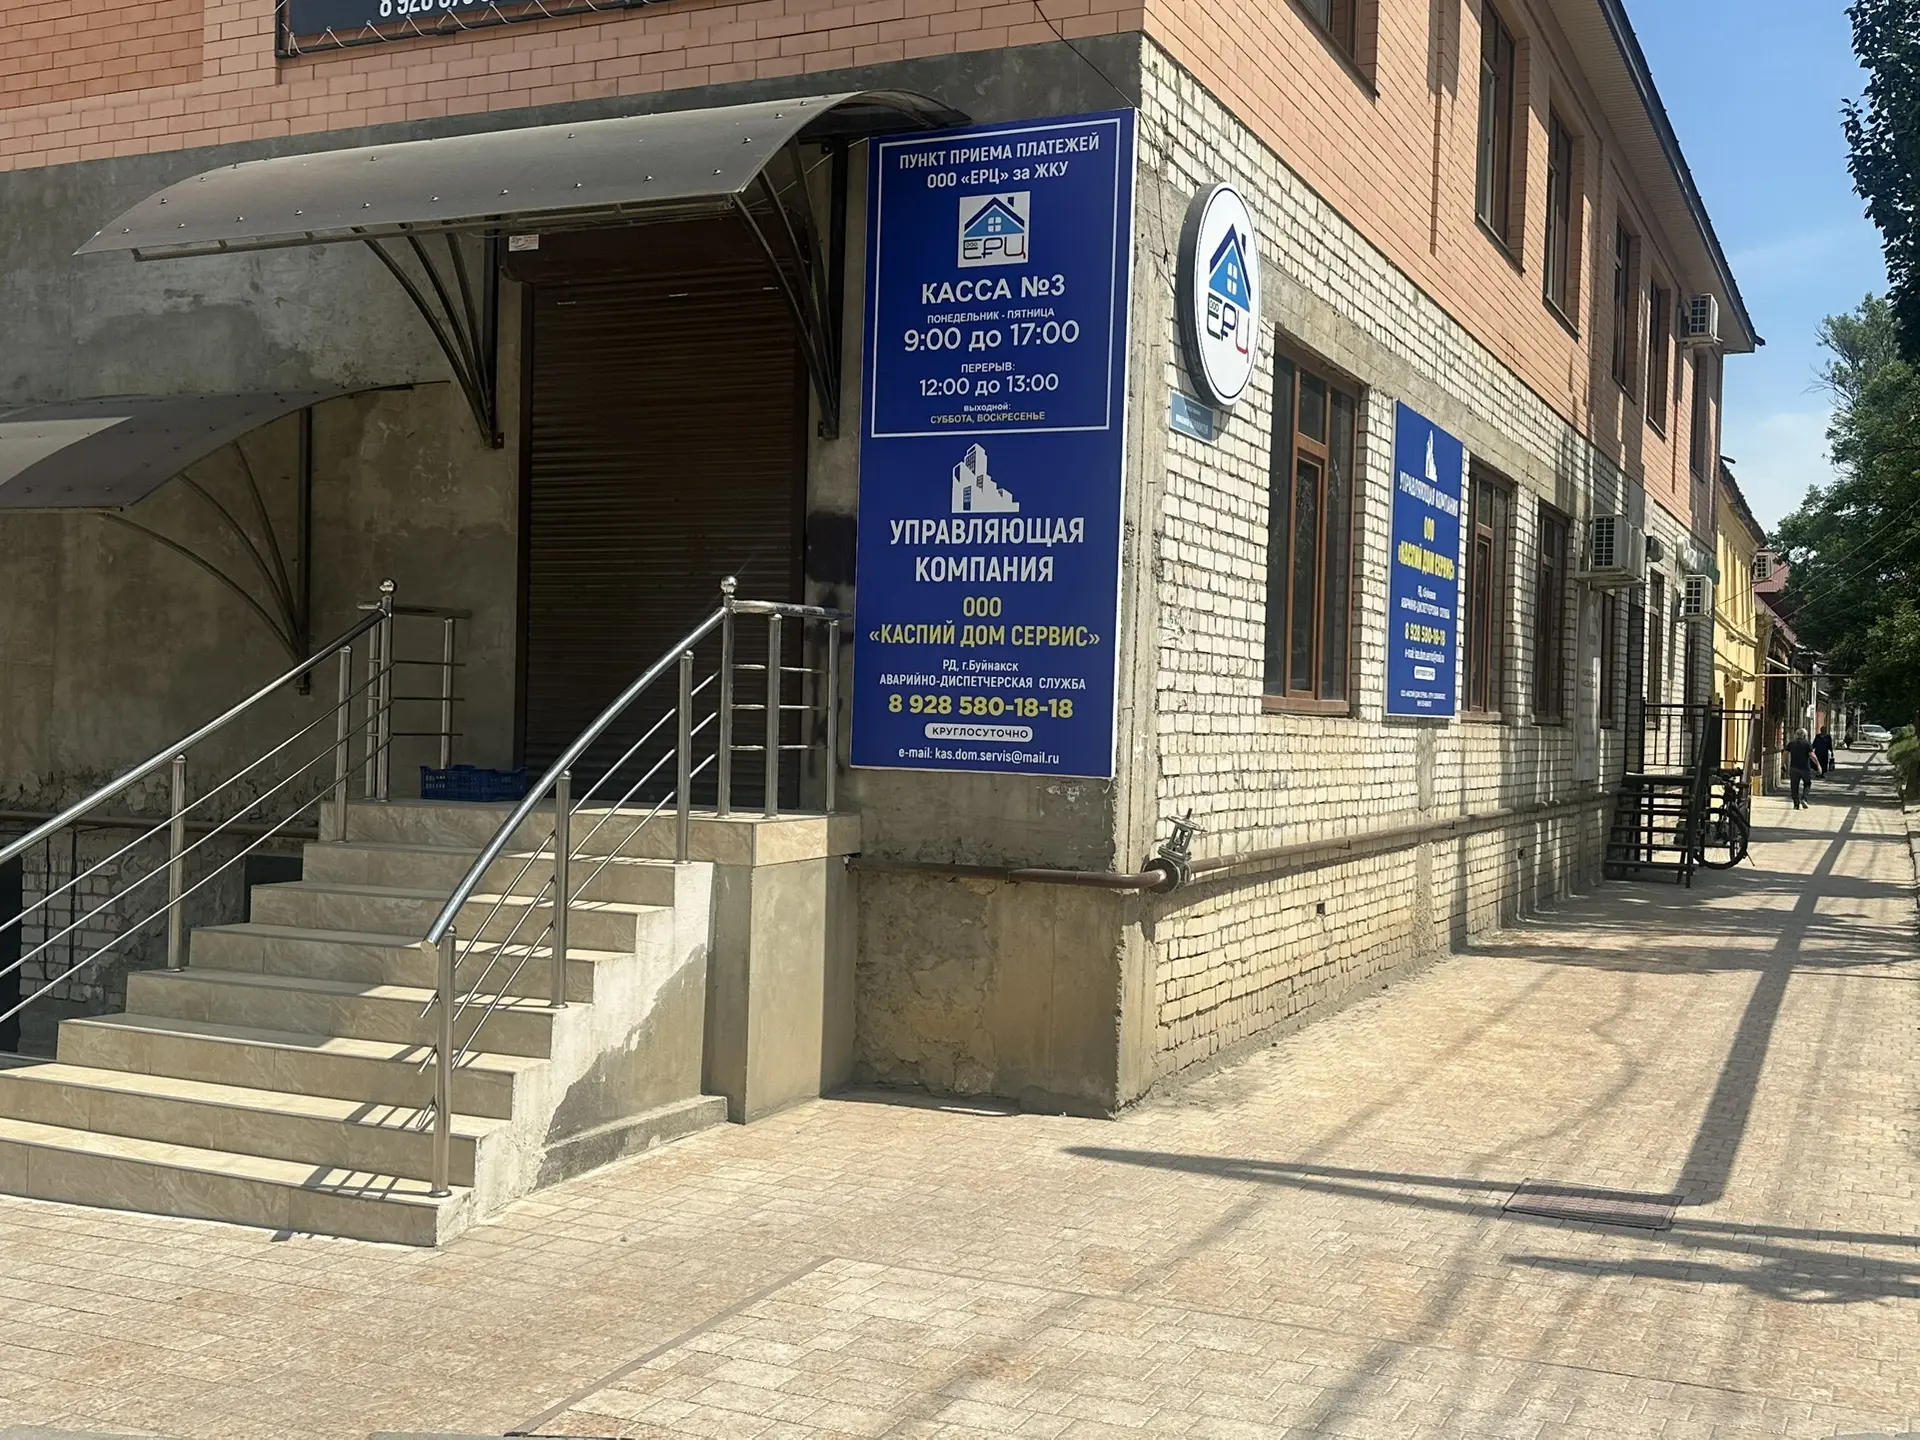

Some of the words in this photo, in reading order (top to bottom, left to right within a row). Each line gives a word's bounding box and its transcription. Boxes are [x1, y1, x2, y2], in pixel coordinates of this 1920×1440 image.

[900, 150, 946, 169] ПУНКТ
[950, 144, 1013, 164] ПРИЕМА
[1016, 132, 1100, 158] ПЛАТЕЖЕЙ
[927, 173, 957, 188] ООО
[961, 168, 1008, 186] «ЕРЦ»
[1013, 167, 1030, 180] за
[1034, 161, 1069, 178] ЖКУ
[922, 278, 1012, 305] КАССА
[1021, 274, 1066, 298] №3
[927, 311, 999, 324] ПОНЕДЕЛЬНИК
[1007, 308, 1055, 319] ПЯТНИЦА
[904, 328, 961, 351] 9:00
[969, 329, 1001, 351] до
[1010, 320, 1080, 346] 17:00
[961, 362, 1015, 373] ПЕРЕРЫВ:
[919, 378, 970, 396] 12:00
[975, 380, 1000, 396] до
[1006, 374, 1059, 393] 13:00
[930, 414, 975, 424] СУББОТА,
[977, 411, 1045, 422] ВОСКРЕСЕНЬЕ
[890, 517, 1085, 547] УПРАВЛЯЮЩАЯ
[915, 556, 1054, 582] КОМПАНИЯ
[963, 596, 1002, 617] ООО
[869, 620, 955, 645] «КАСПИЙ
[960, 624, 1005, 648] ДОМ
[1011, 625, 1100, 647] СЕРВИС»
[942, 659, 960, 672] РД,
[962, 659, 1019, 673] г.Буйнакск
[879, 672, 1033, 688] АВАРИЙНО-ДИСПЕТЧЕРСКАЯ
[1038, 677, 1086, 690] СЛУЖБА
[888, 694, 903, 713] 8
[909, 694, 952, 715] 928
[958, 696, 1074, 719] 580-18-18
[932, 726, 1029, 739] КРУГЛОСУТОЧНО
[898, 747, 933, 759] e-mail:
[935, 748, 1060, 765] kas.dom.servis@mail.ru
